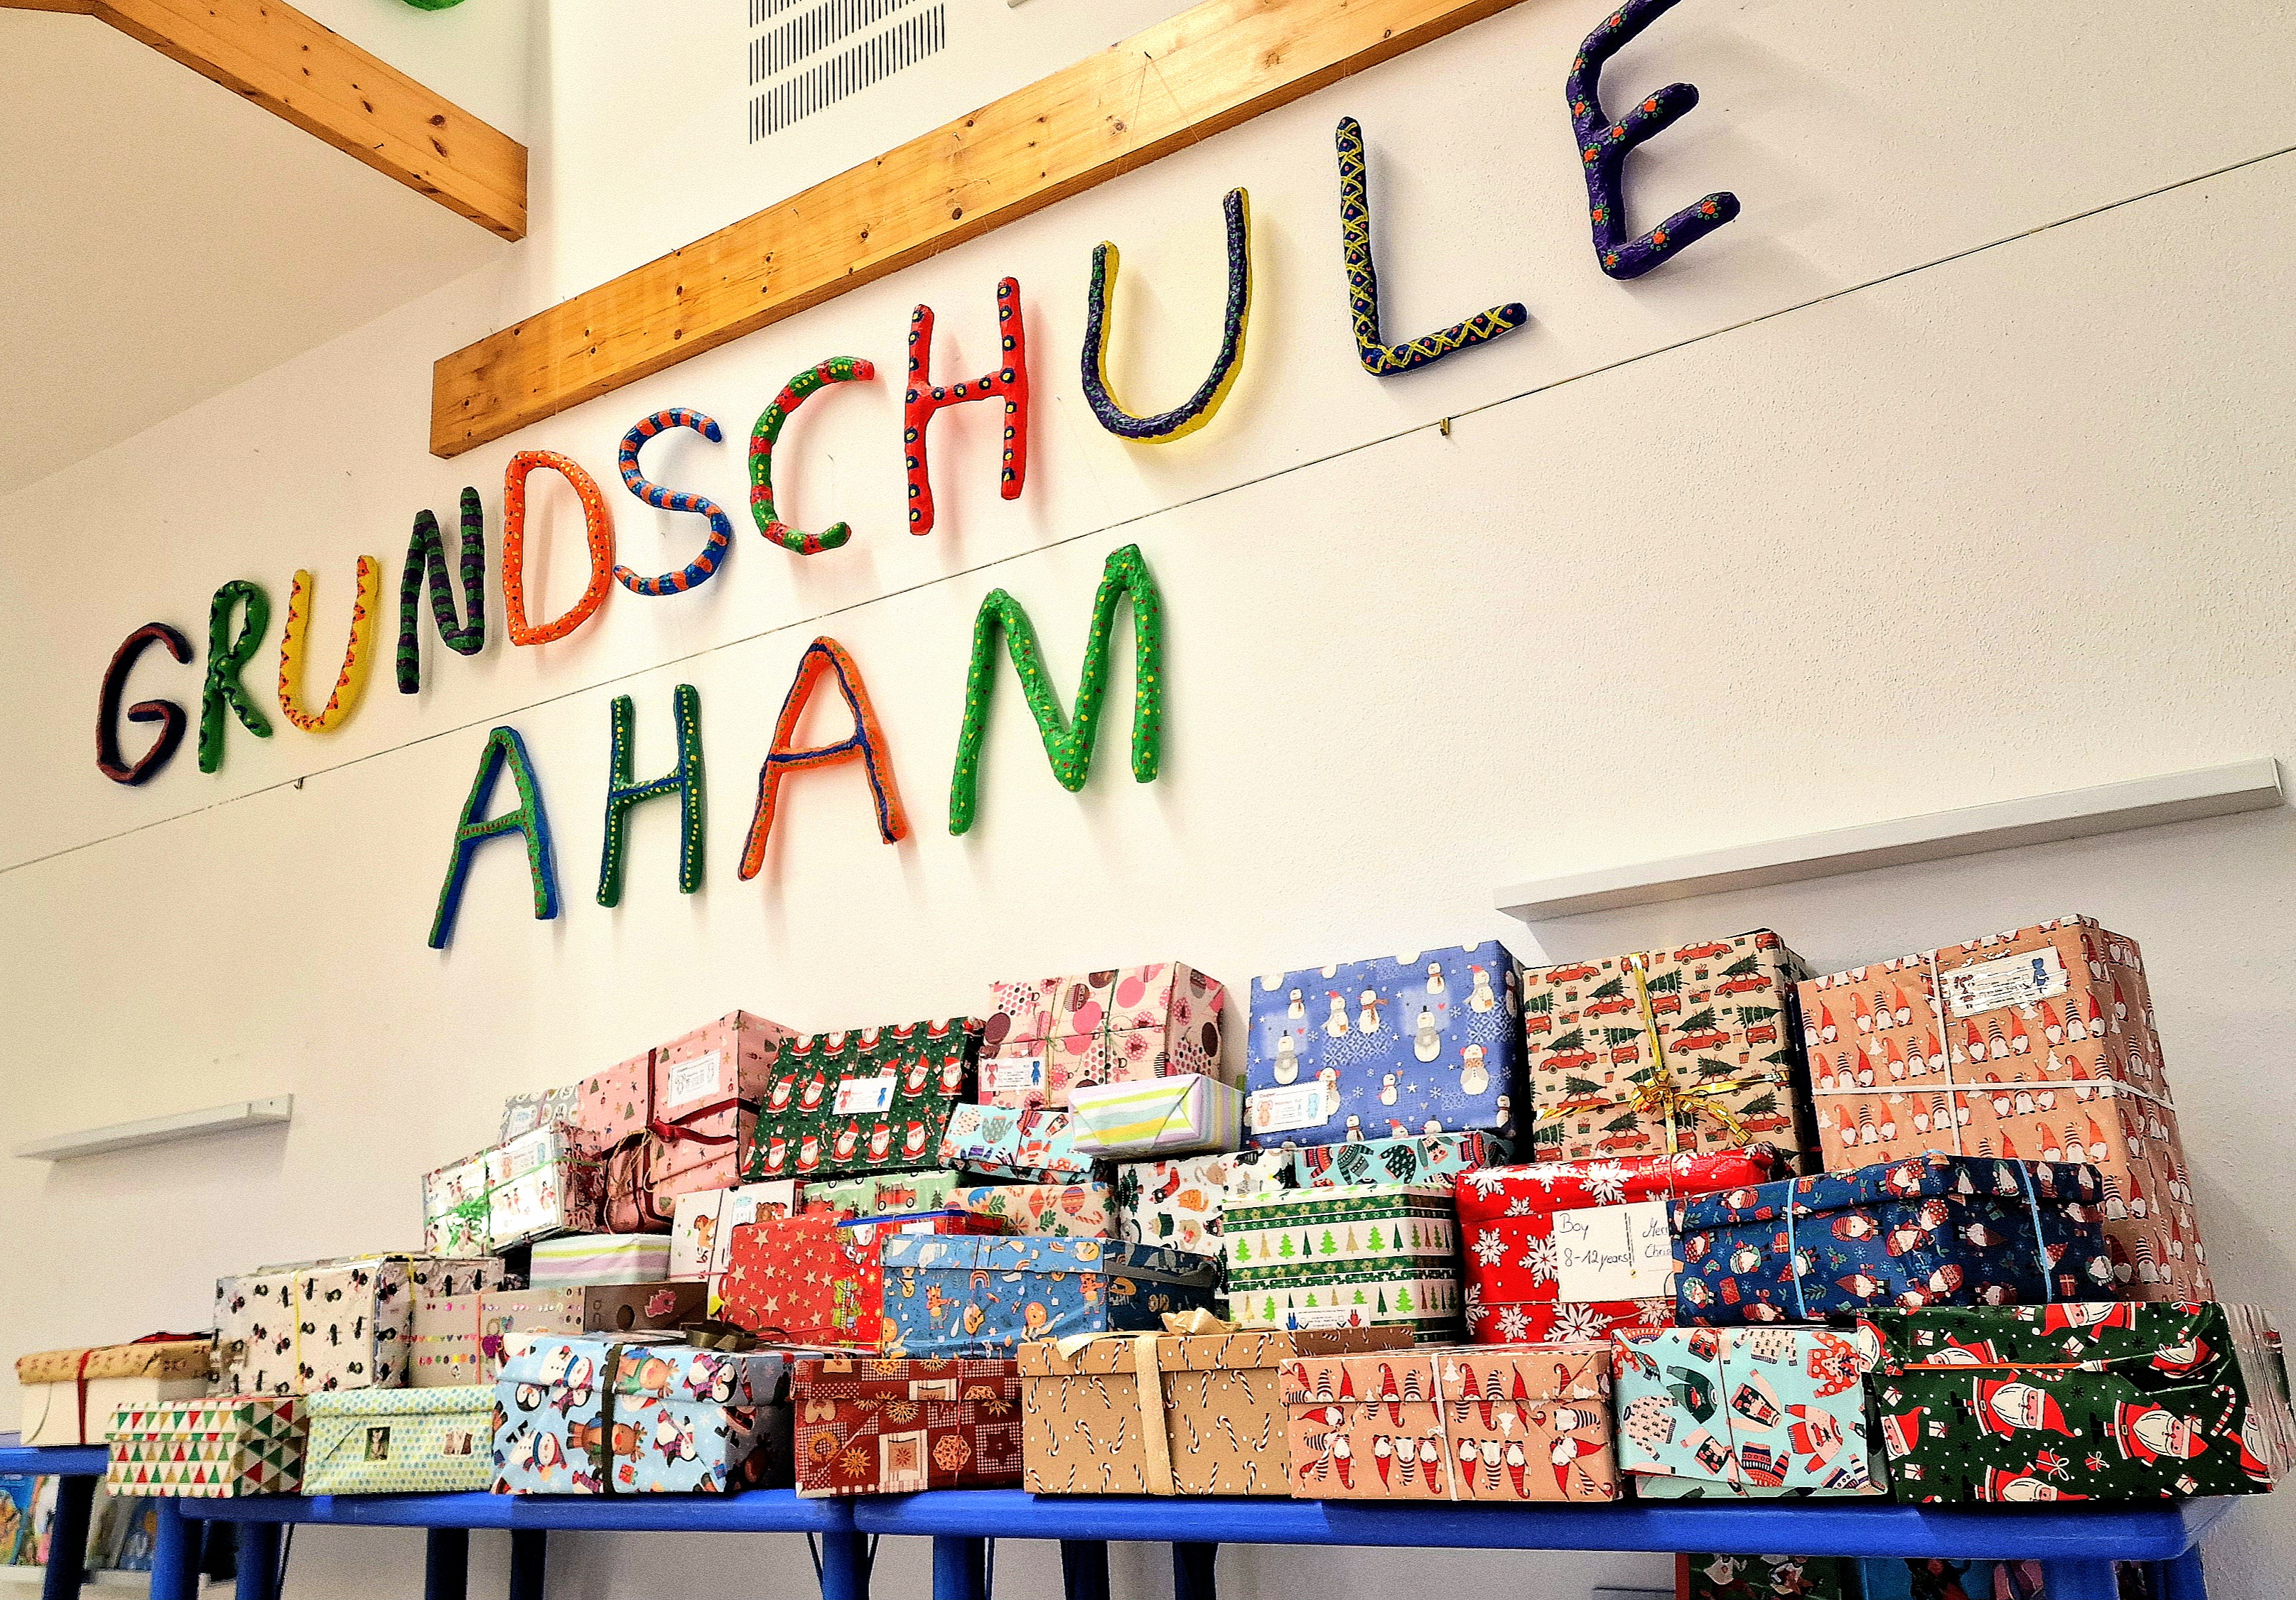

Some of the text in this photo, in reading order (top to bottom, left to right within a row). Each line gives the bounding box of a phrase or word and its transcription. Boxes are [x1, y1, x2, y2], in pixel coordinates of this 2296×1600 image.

[95, 0, 1740, 786] GRUNDSCHULE
[428, 544, 1161, 949] AHAM
[1559, 1213, 1589, 1240] Boy
